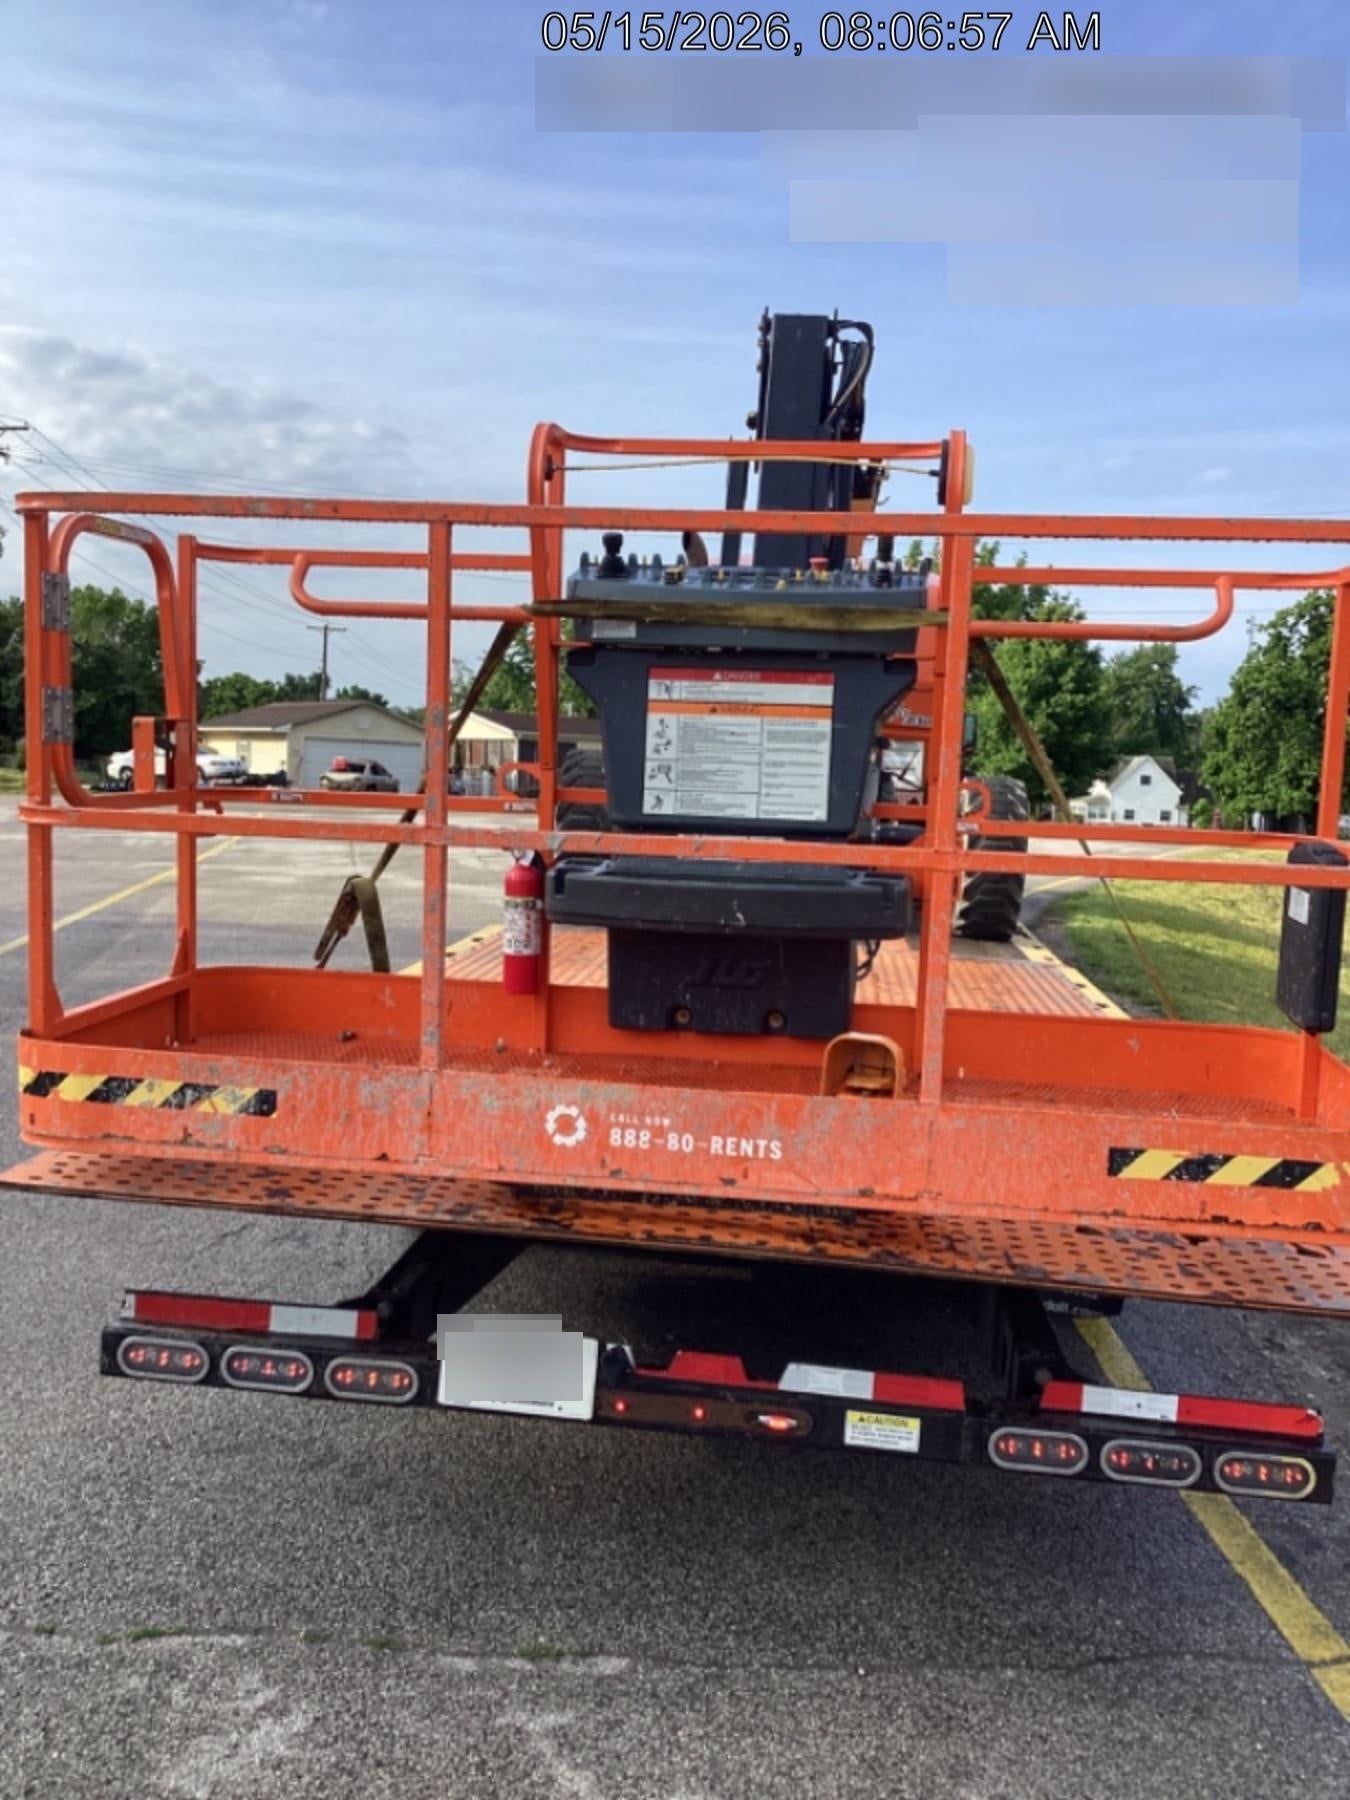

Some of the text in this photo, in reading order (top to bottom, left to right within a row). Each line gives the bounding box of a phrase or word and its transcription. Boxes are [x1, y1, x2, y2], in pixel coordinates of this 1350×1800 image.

[609, 1112, 671, 1127] CALL NOW
[609, 1127, 782, 1159] 888-80-RENTS
